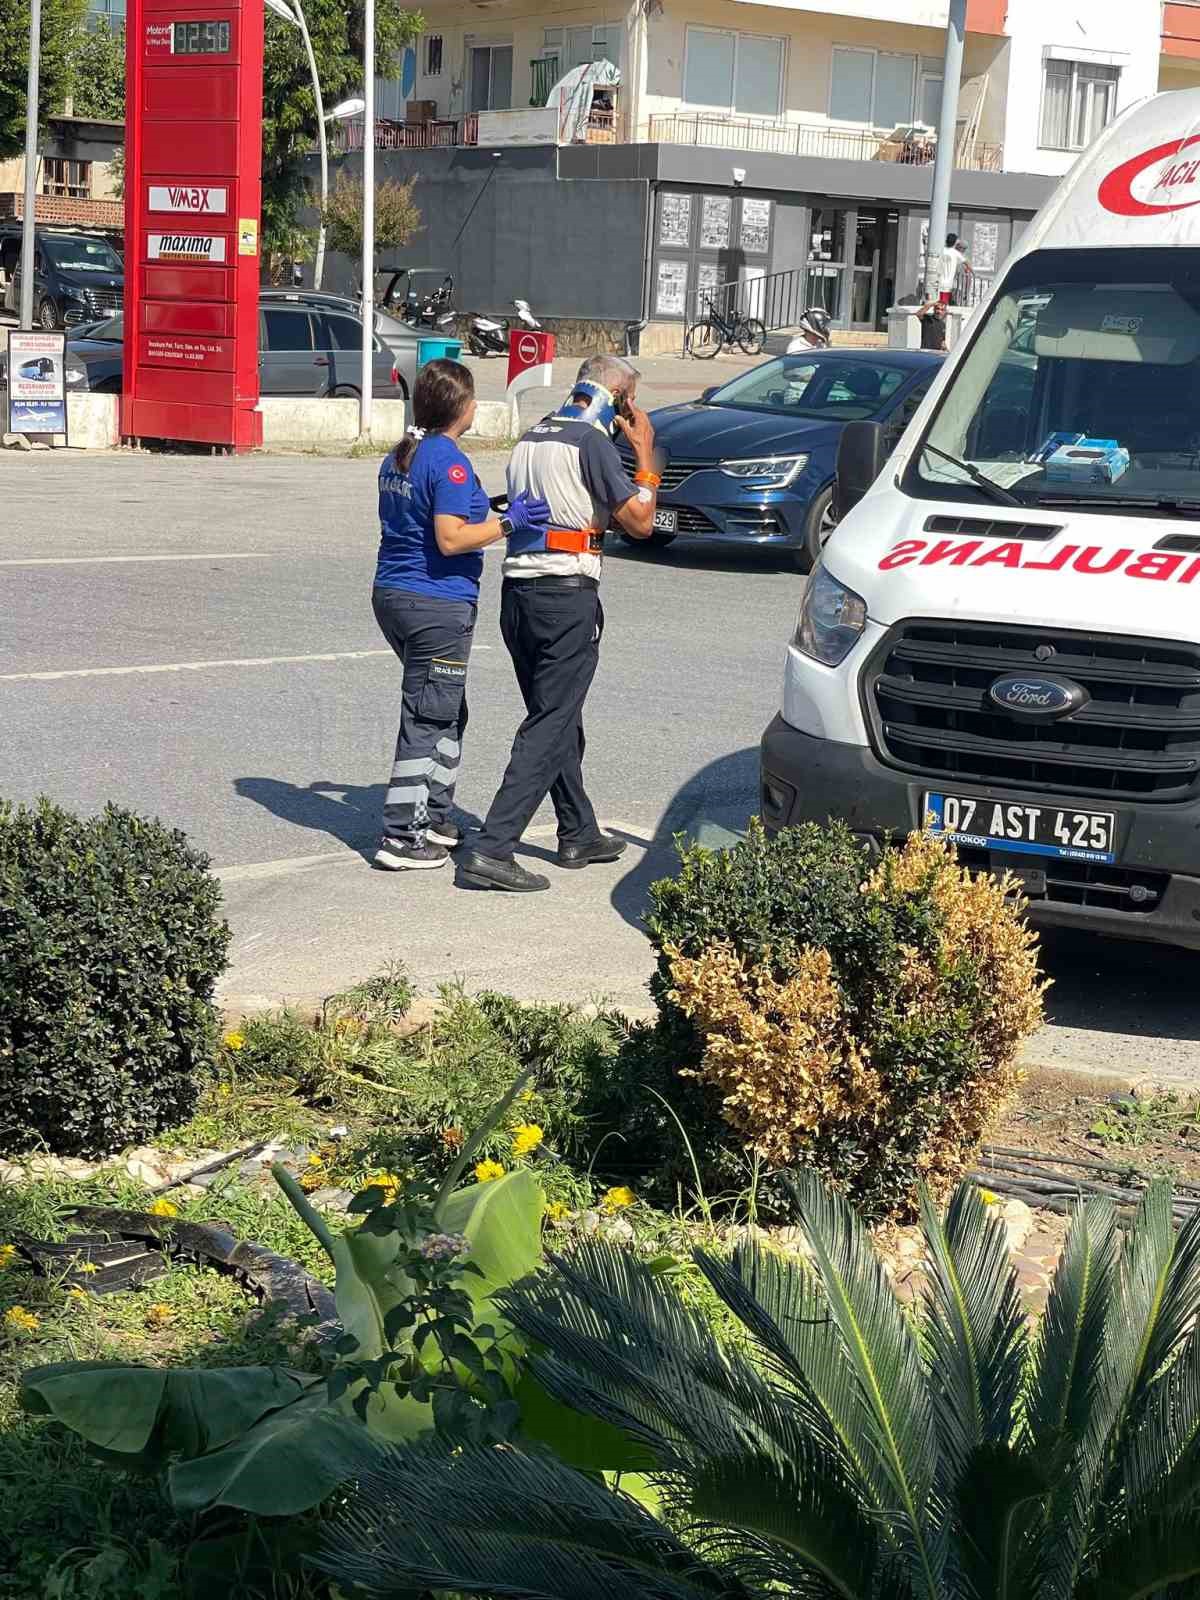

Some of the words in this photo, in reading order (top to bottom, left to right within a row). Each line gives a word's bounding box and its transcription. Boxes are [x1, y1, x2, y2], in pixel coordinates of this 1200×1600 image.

[160, 235, 212, 253] maxima
[656, 512, 674, 527] 529
[1007, 683, 1053, 705] Ford
[944, 797, 977, 831] 07
[989, 803, 1041, 841] AST
[1054, 812, 1107, 849] 425
[949, 834, 987, 846] OTOKOÇ
